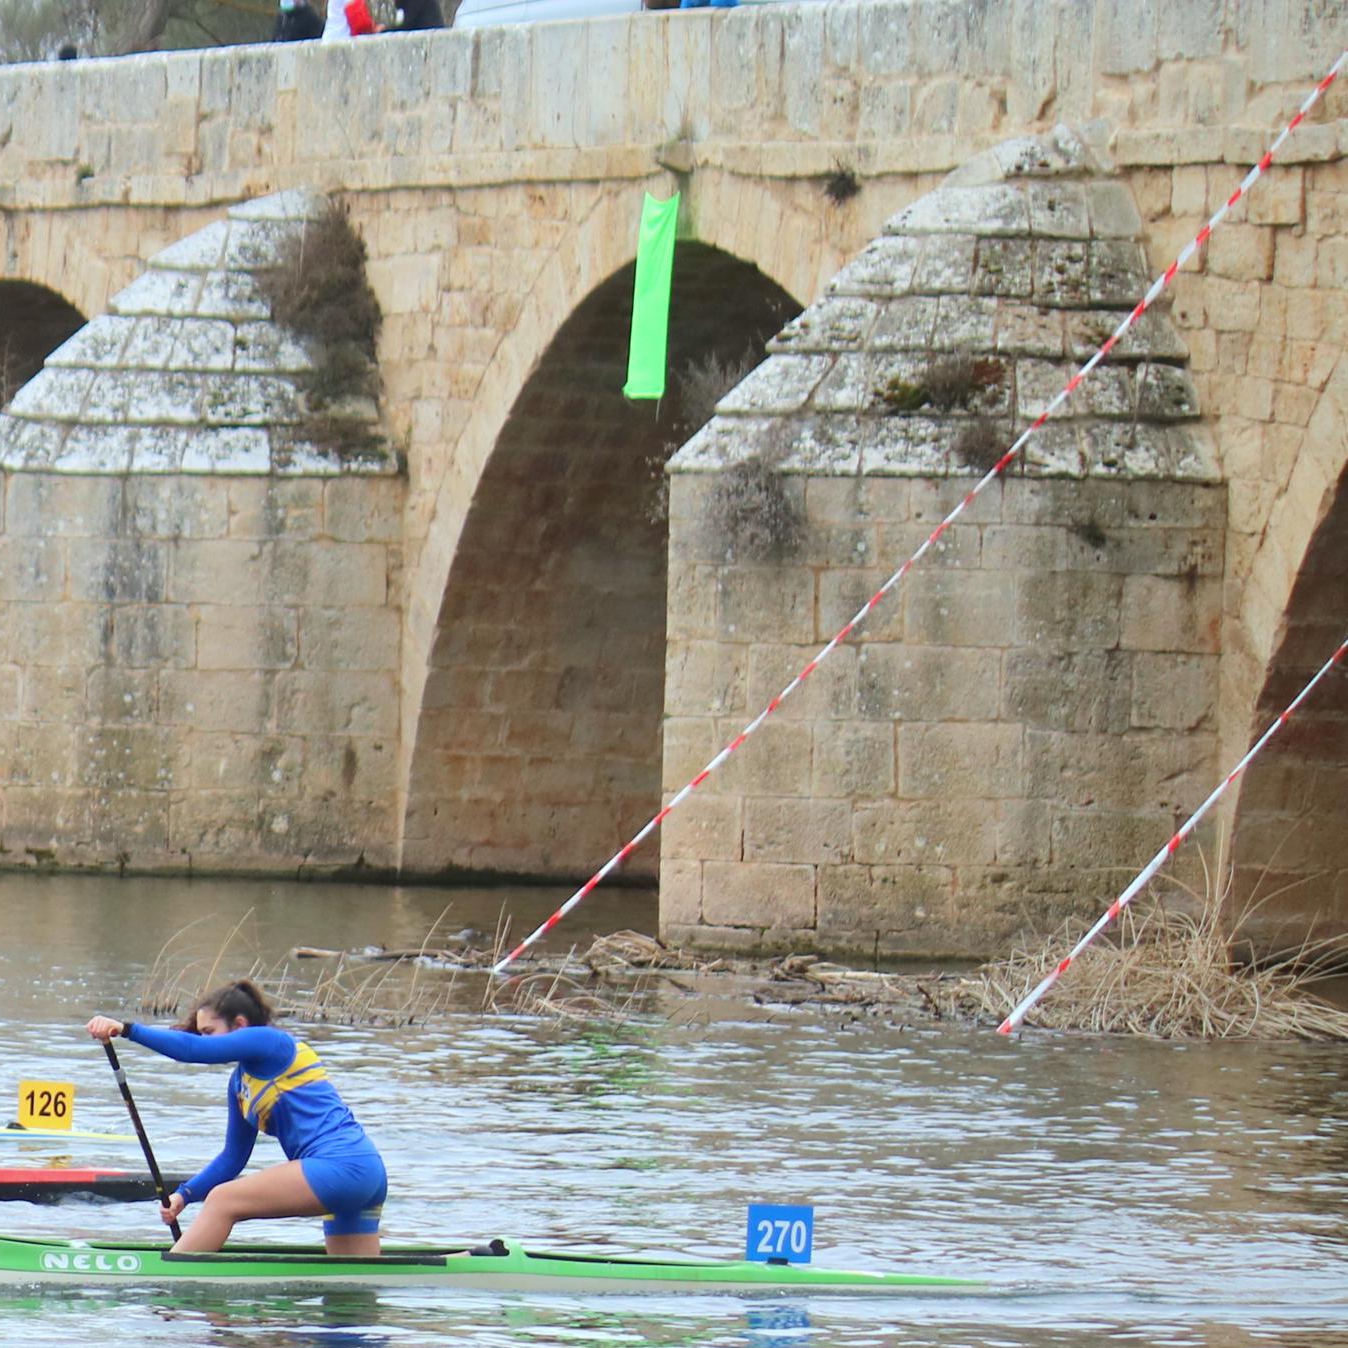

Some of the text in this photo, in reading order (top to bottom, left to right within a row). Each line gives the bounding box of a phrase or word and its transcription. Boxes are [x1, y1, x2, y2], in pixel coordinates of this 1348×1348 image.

[26, 1090, 67, 1118] 126
[756, 1220, 807, 1254] 270
[44, 1253, 139, 1271] NELO
